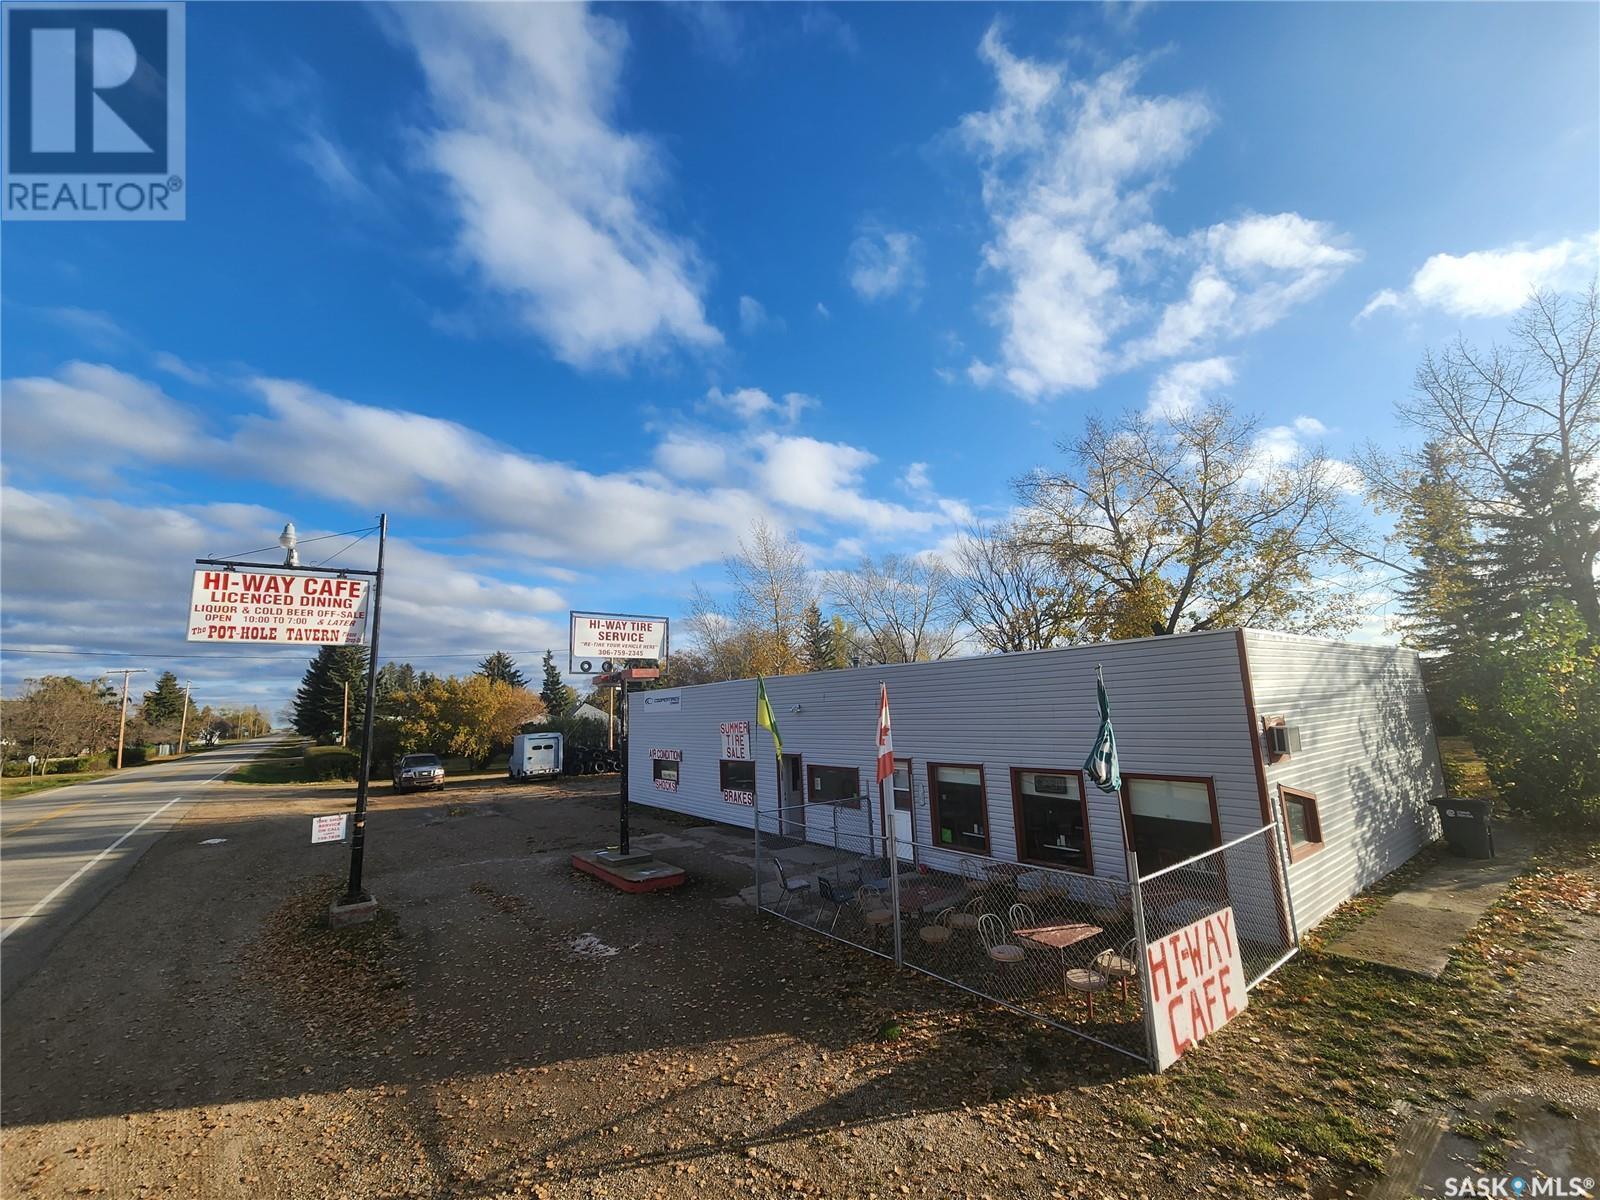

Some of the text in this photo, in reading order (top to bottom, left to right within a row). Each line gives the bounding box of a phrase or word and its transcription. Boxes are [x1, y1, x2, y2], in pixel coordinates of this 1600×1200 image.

[203, 572, 361, 598] HI-WAY CAFE
[210, 591, 353, 609] LICENCED DINING
[194, 604, 237, 613] LIQUOR
[254, 607, 283, 615] COLD
[286, 608, 314, 617] BEER
[317, 610, 365, 619] OFF-SALE
[205, 614, 232, 622] OPEN
[244, 615, 270, 623] 10:00
[273, 616, 284, 624] TO
[288, 617, 307, 625] 7:00
[327, 619, 357, 627] LATER
[589, 620, 653, 632] HI-WAY TIRE
[207, 625, 277, 640] POT-HOLE
[286, 628, 340, 642] TAVERN
[598, 631, 645, 642] SERVICE
[720, 721, 748, 734] SUMMER
[726, 735, 745, 747] TIRE
[726, 747, 746, 759] SALE
[723, 789, 753, 806] BRAKES
[1147, 911, 1232, 1002] HI-WAY
[1167, 965, 1237, 1056] CAFE
